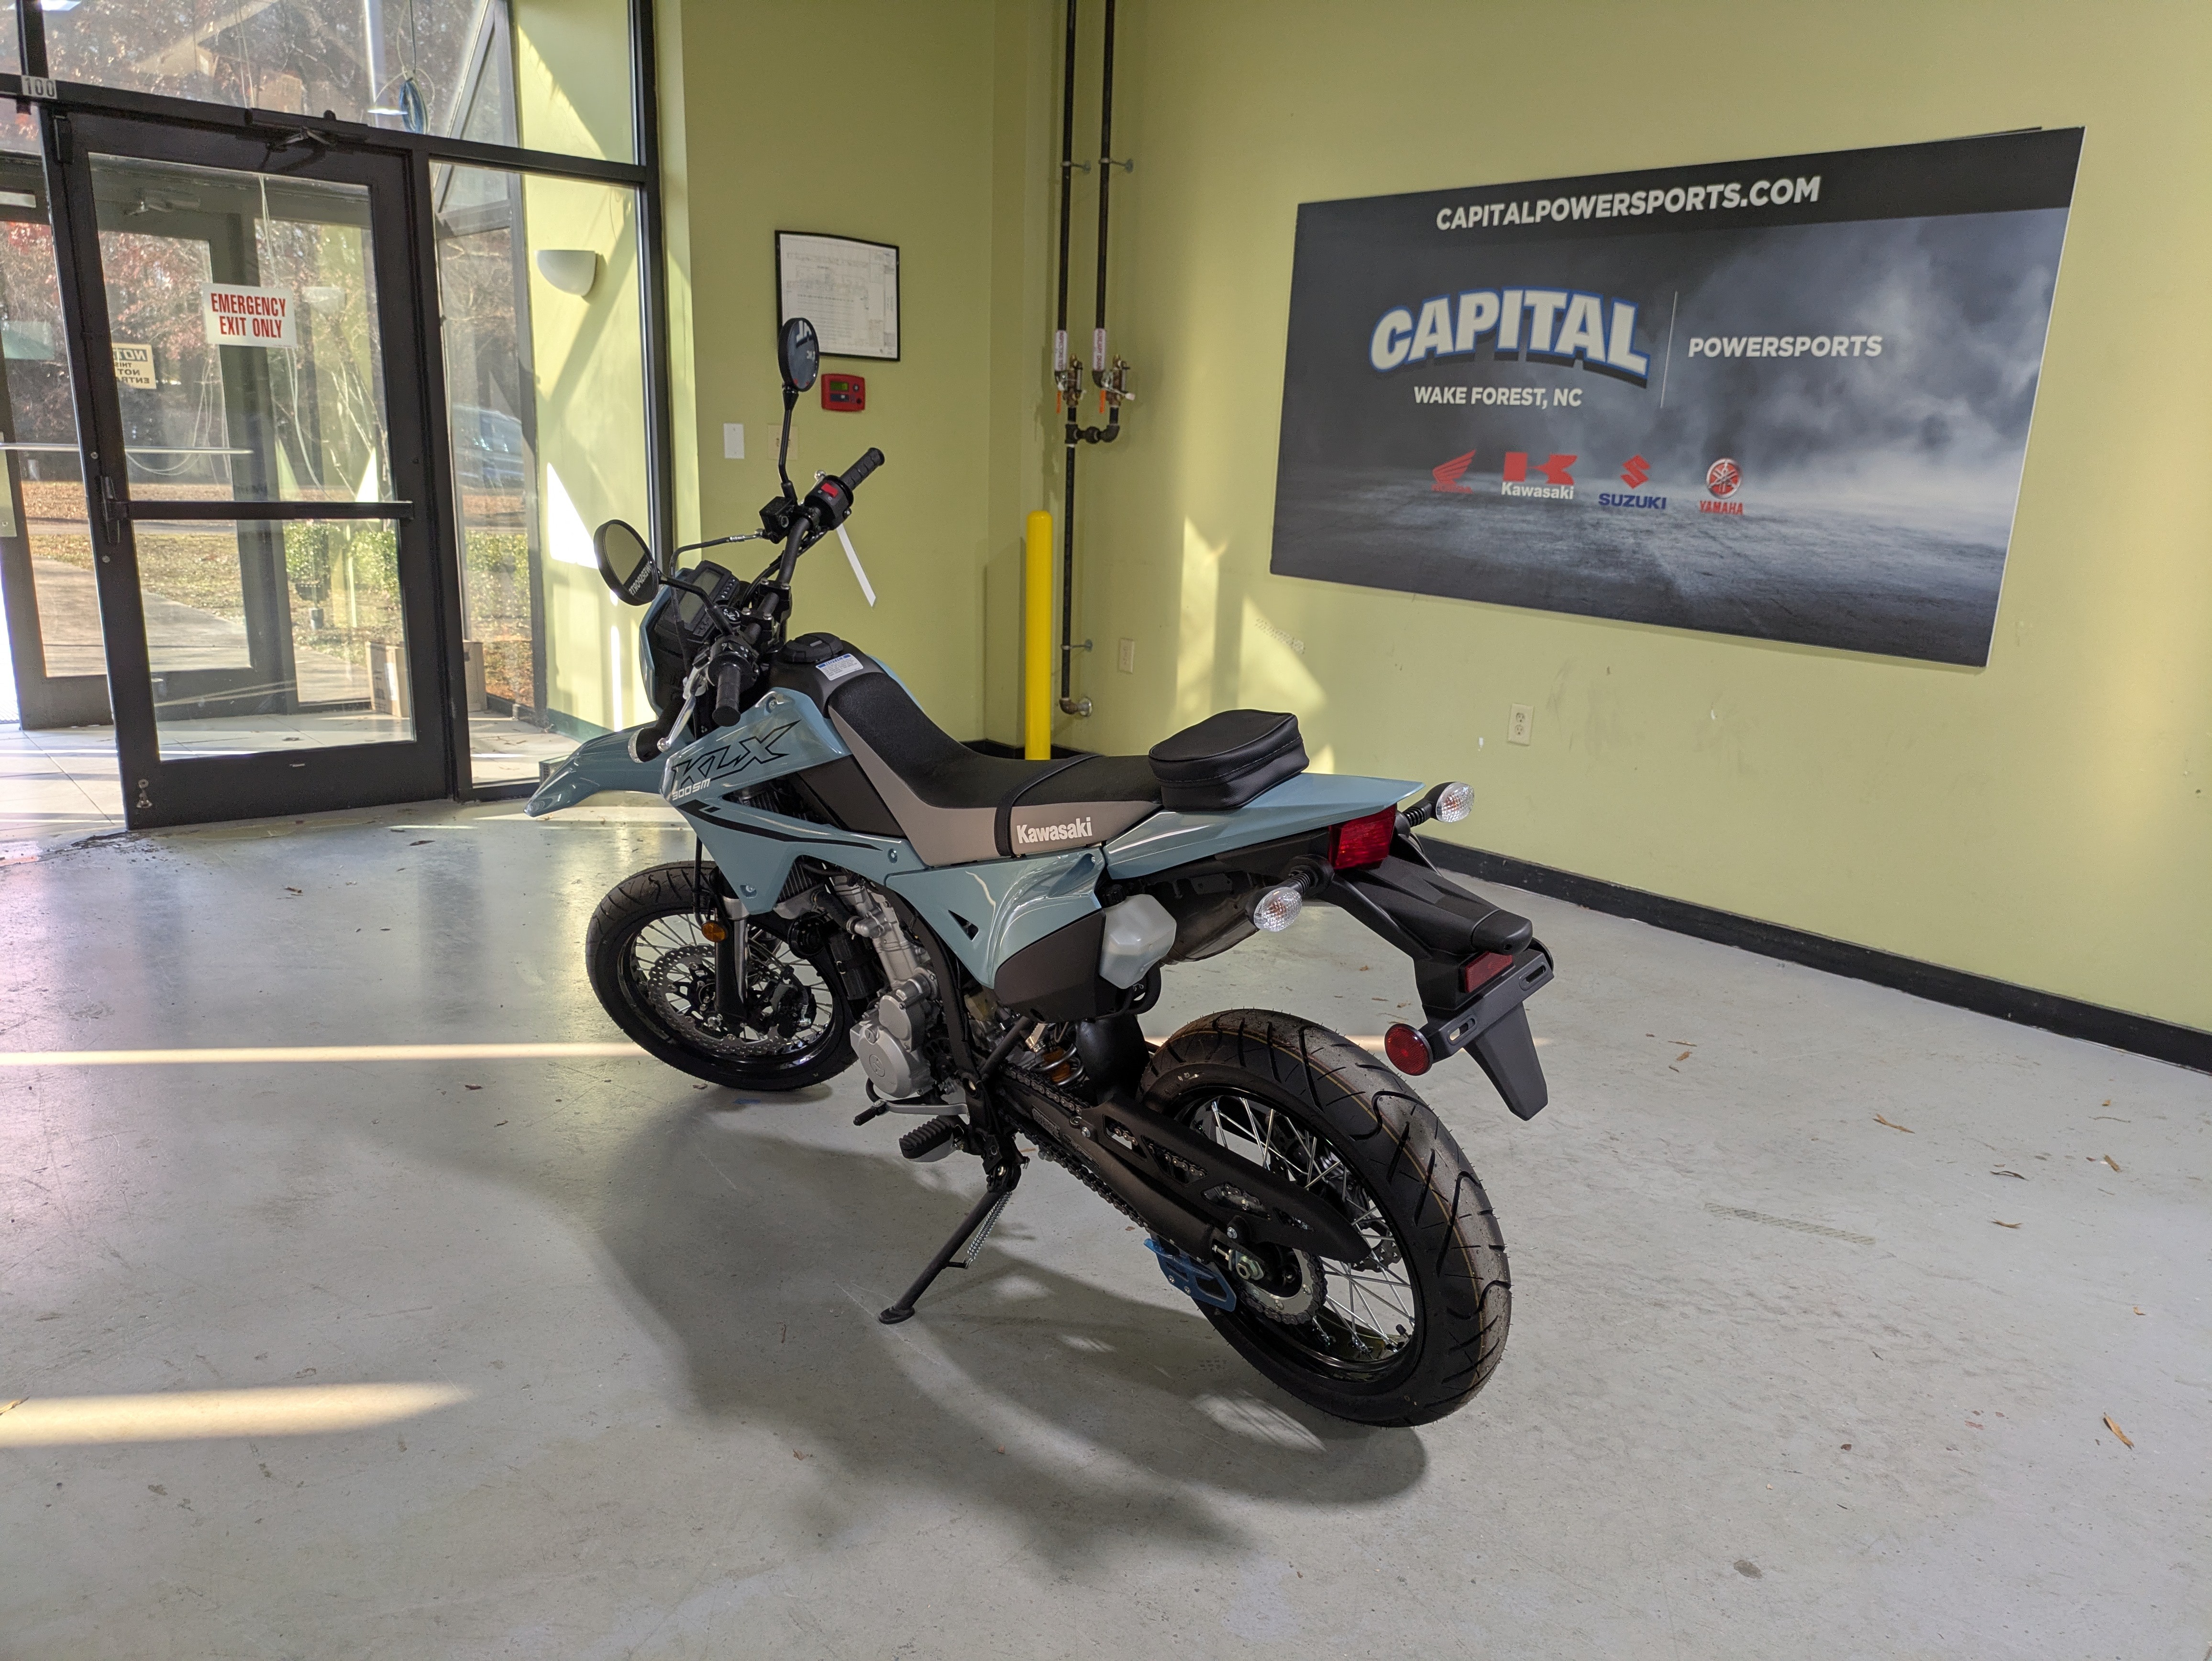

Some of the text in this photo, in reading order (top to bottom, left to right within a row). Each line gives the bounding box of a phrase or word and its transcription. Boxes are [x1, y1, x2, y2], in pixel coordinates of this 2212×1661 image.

[25, 78, 55, 97] 100
[1436, 176, 1821, 230] CAPITALPOWERSPORTS.COM
[211, 293, 286, 317] EMERGENCY
[220, 316, 282, 339] EXIT ONLY
[1369, 287, 1650, 381] CAPITAL
[1688, 336, 1883, 357] POWERSPORTS
[1414, 386, 1582, 410] WAKE FOREST, NC
[1501, 481, 1574, 500] Kawasaki
[1598, 493, 1667, 510] SUZUKI
[1699, 500, 1744, 516] YAMAHA
[671, 719, 802, 791] KLX
[1017, 817, 1093, 844] Kawasaki
